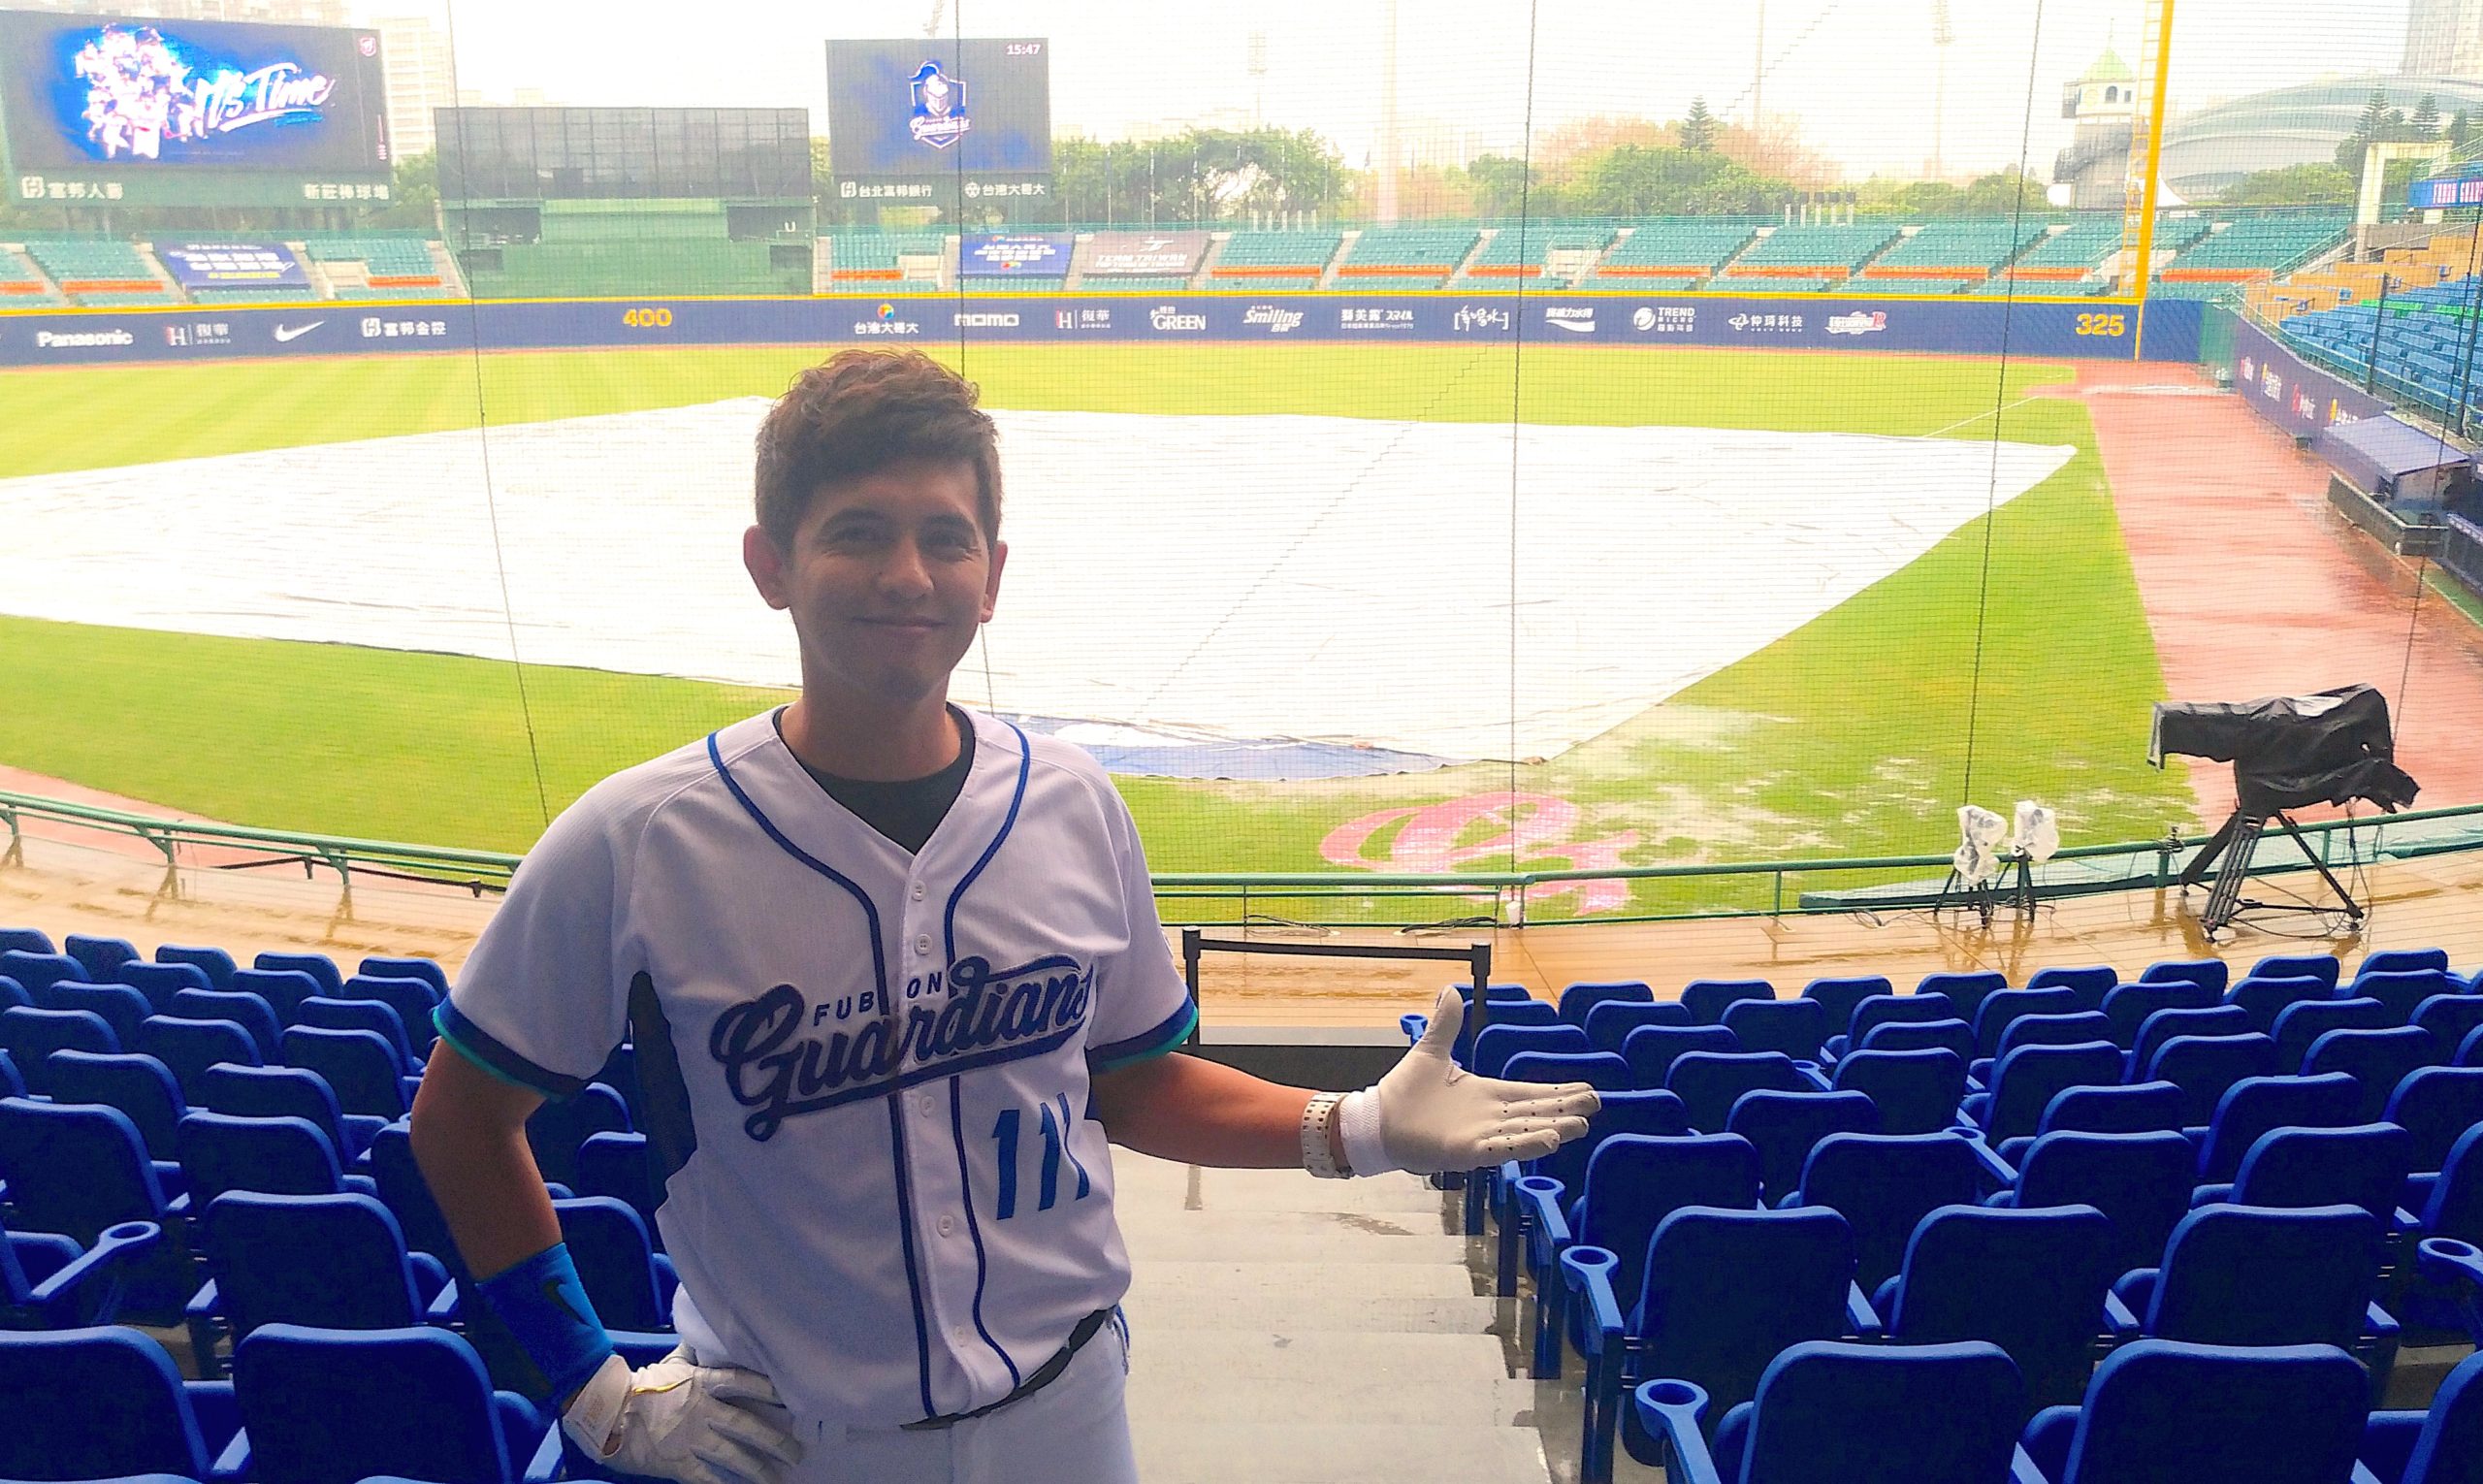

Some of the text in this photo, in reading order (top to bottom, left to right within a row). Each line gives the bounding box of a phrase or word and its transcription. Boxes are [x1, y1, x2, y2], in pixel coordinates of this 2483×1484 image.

[1006, 44, 1042, 55] 15:47
[243, 62, 336, 113] Time
[623, 307, 673, 328] 400
[953, 313, 1020, 327] momo
[1242, 308, 1305, 328] Smiling
[1658, 306, 1695, 317] TREND
[1152, 314, 1207, 331] GREEN
[2076, 312, 2125, 337] 325
[36, 328, 134, 348] Panasonic
[813, 971, 943, 1027] FUBON
[709, 954, 1095, 1143] Guardians
